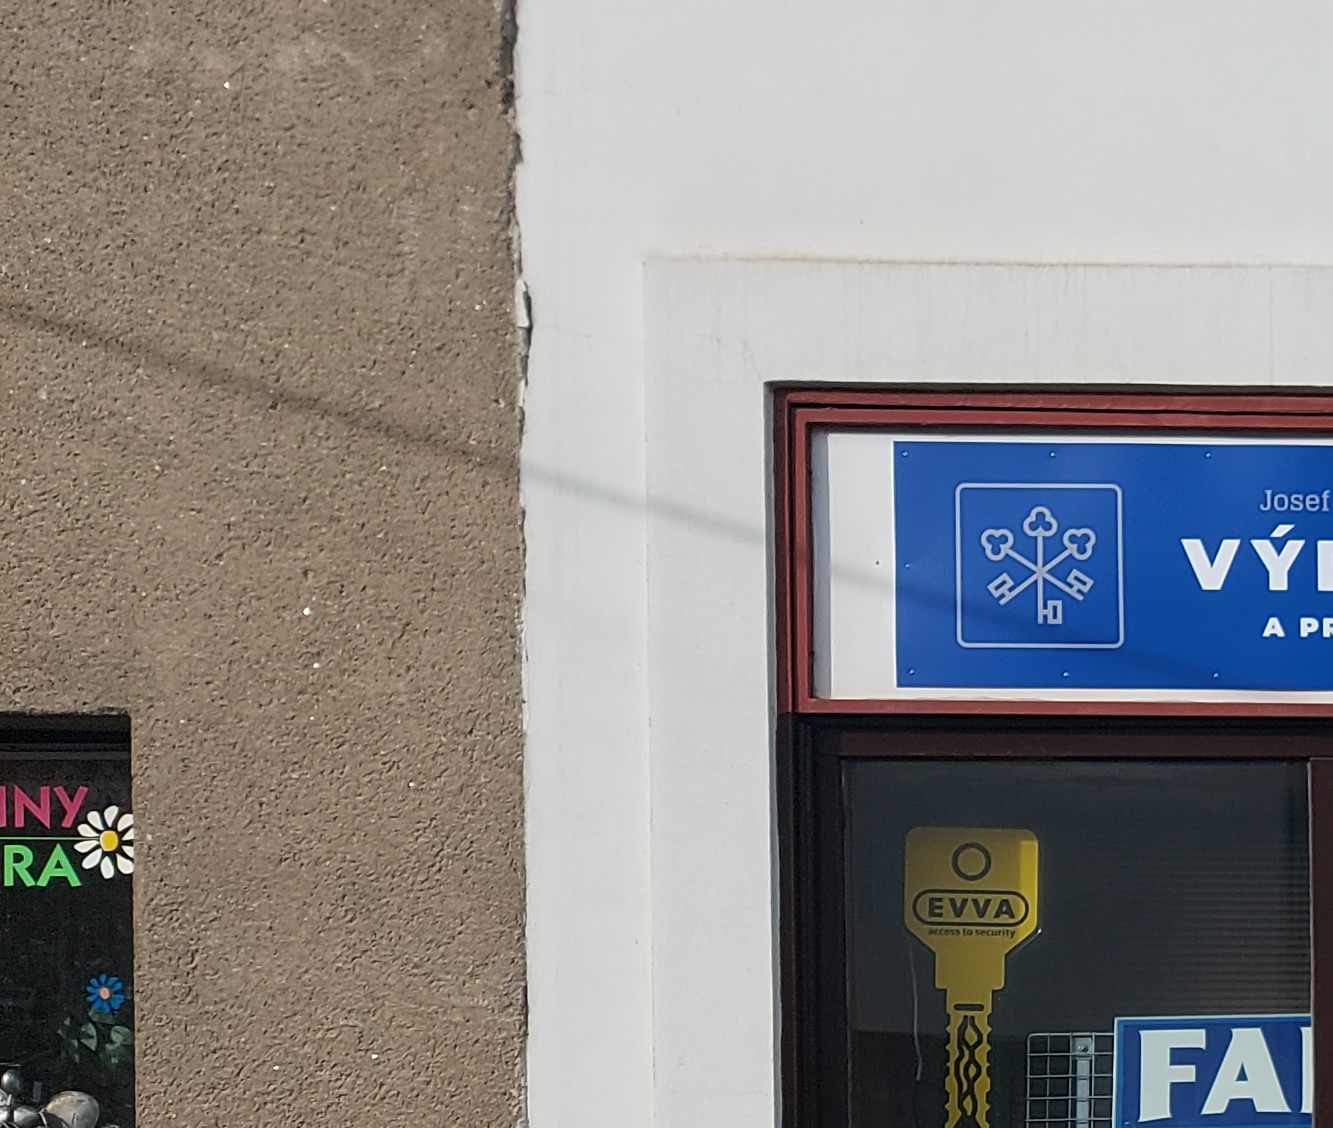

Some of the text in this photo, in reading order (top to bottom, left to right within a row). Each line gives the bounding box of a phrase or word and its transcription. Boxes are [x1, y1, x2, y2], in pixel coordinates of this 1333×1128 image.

[1259, 490, 1331, 512] Josef
[1262, 617, 1286, 638] A
[928, 897, 1016, 919] EVVA
[928, 926, 1016, 939] access to security
